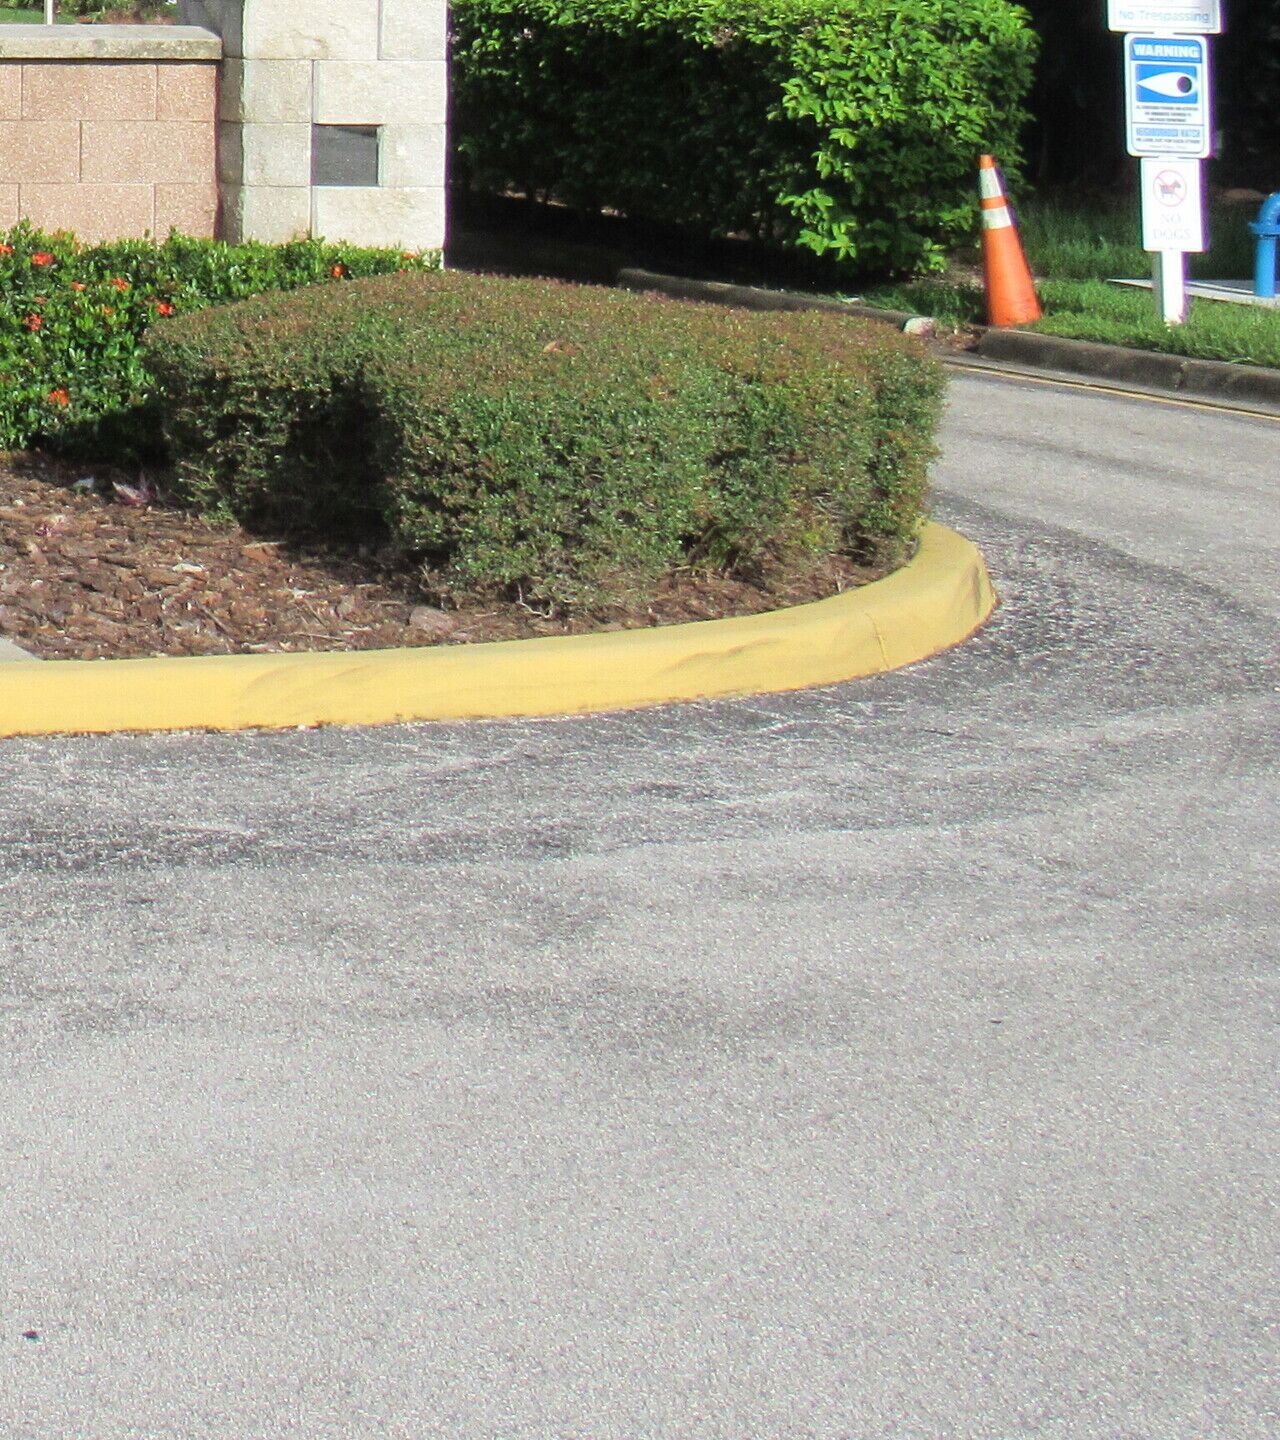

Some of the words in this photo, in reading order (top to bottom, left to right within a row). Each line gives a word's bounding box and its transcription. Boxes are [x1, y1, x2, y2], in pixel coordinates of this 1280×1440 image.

[1139, 10, 1210, 23] Trespassing
[1133, 44, 1200, 58] WARNING
[1161, 212, 1182, 224] NO
[1153, 228, 1191, 241] DOGS
